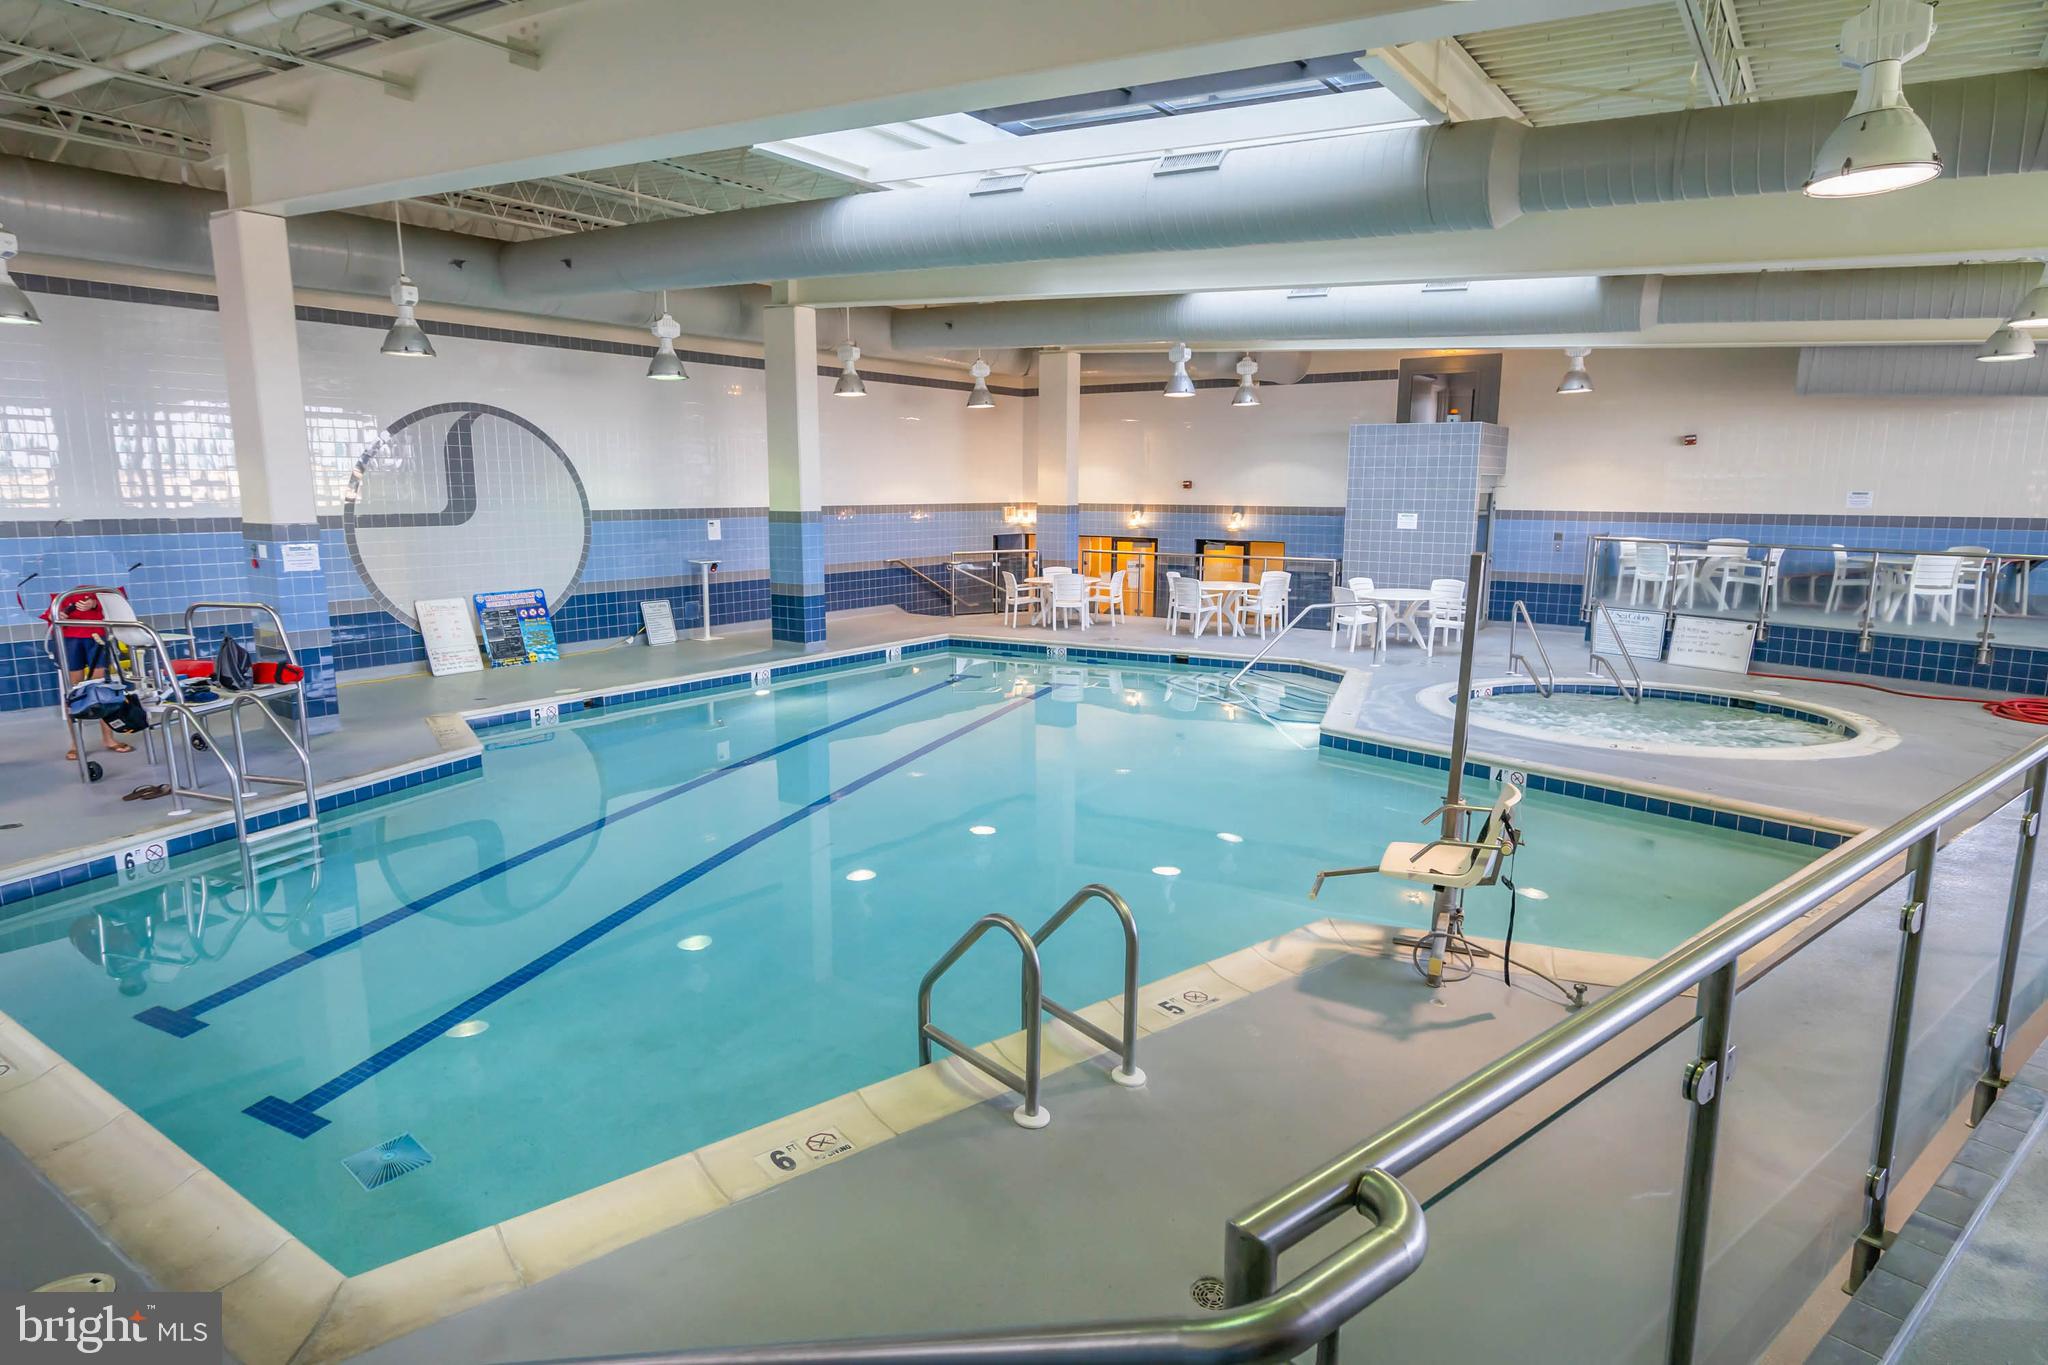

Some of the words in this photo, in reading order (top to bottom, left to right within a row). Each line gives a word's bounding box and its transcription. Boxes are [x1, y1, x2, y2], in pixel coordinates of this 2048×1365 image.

[534, 708, 541, 719] 5
[1495, 769, 1503, 781] 4
[124, 852, 135, 869] 6
[1158, 1001, 1185, 1015] 5
[770, 1150, 797, 1172] 6
[785, 1143, 798, 1153] FT
